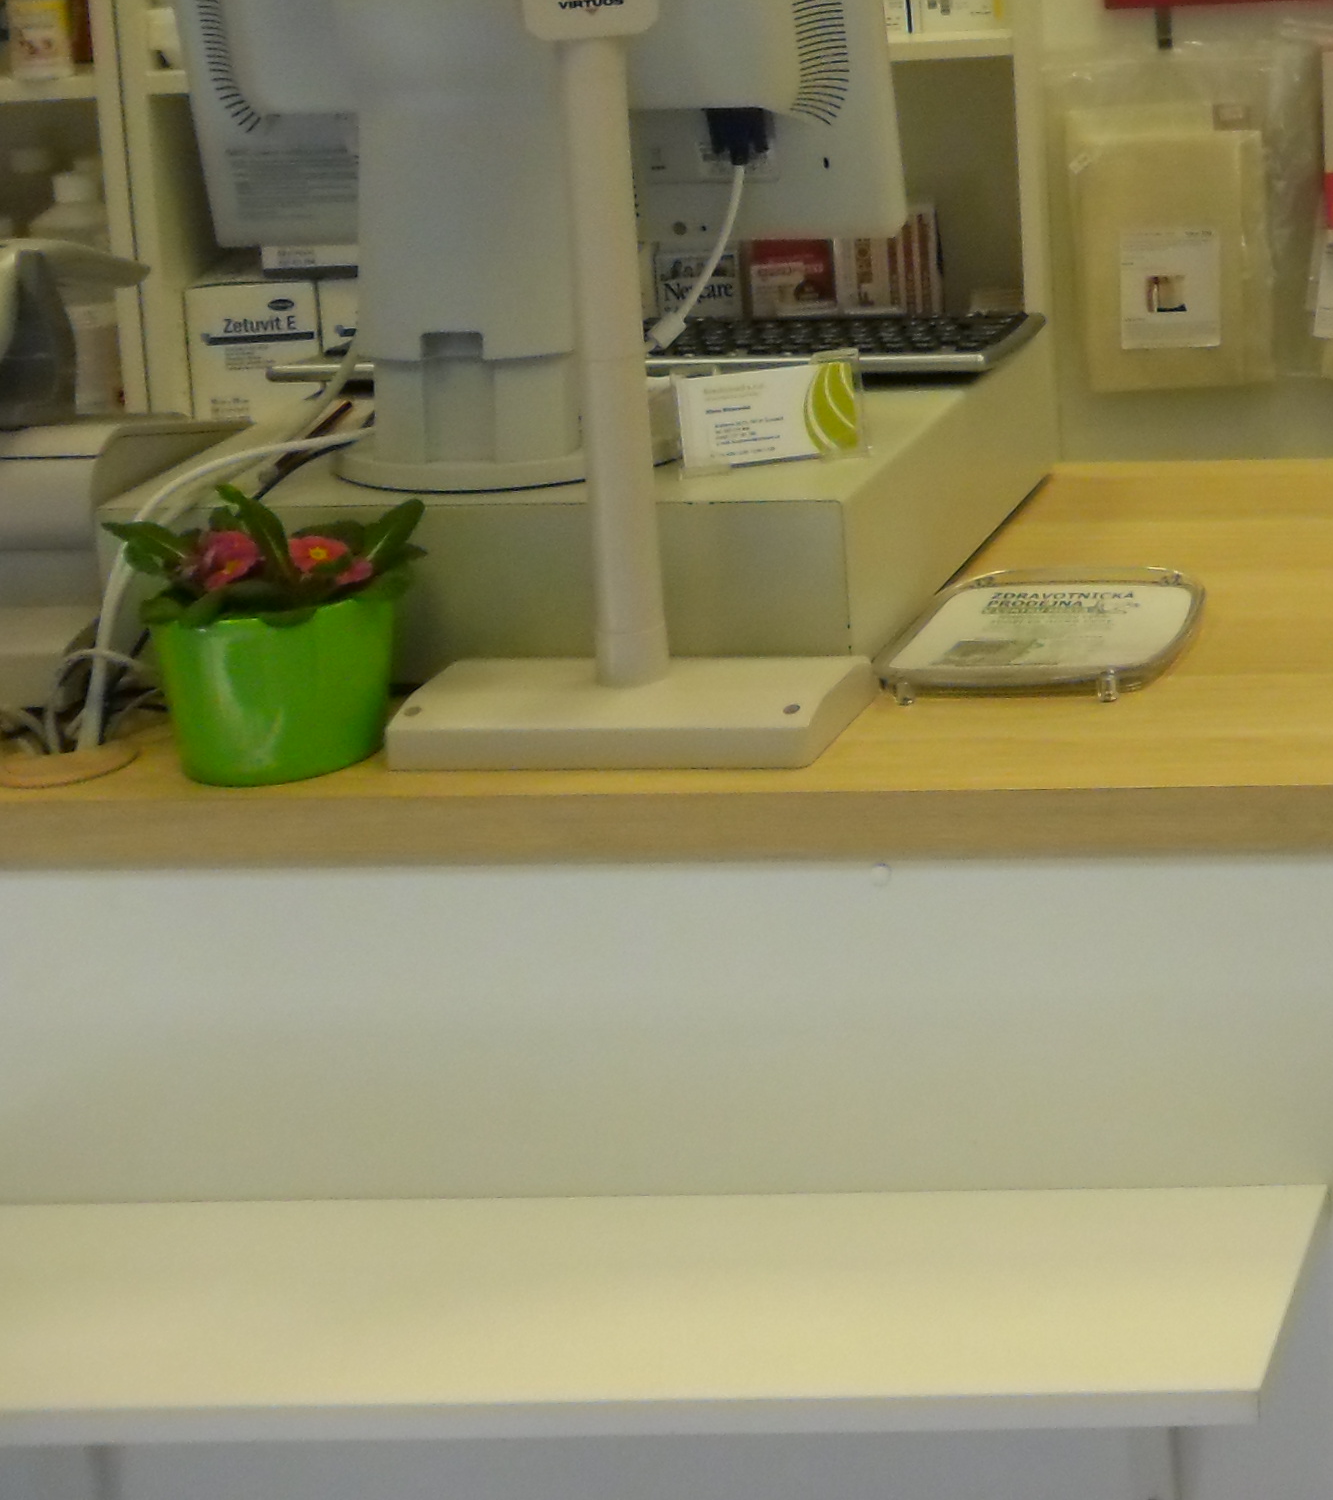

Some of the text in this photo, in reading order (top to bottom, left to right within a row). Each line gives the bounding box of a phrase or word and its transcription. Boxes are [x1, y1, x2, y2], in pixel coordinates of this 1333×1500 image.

[664, 282, 733, 301] Necare
[223, 315, 297, 334] Zetuvit E
